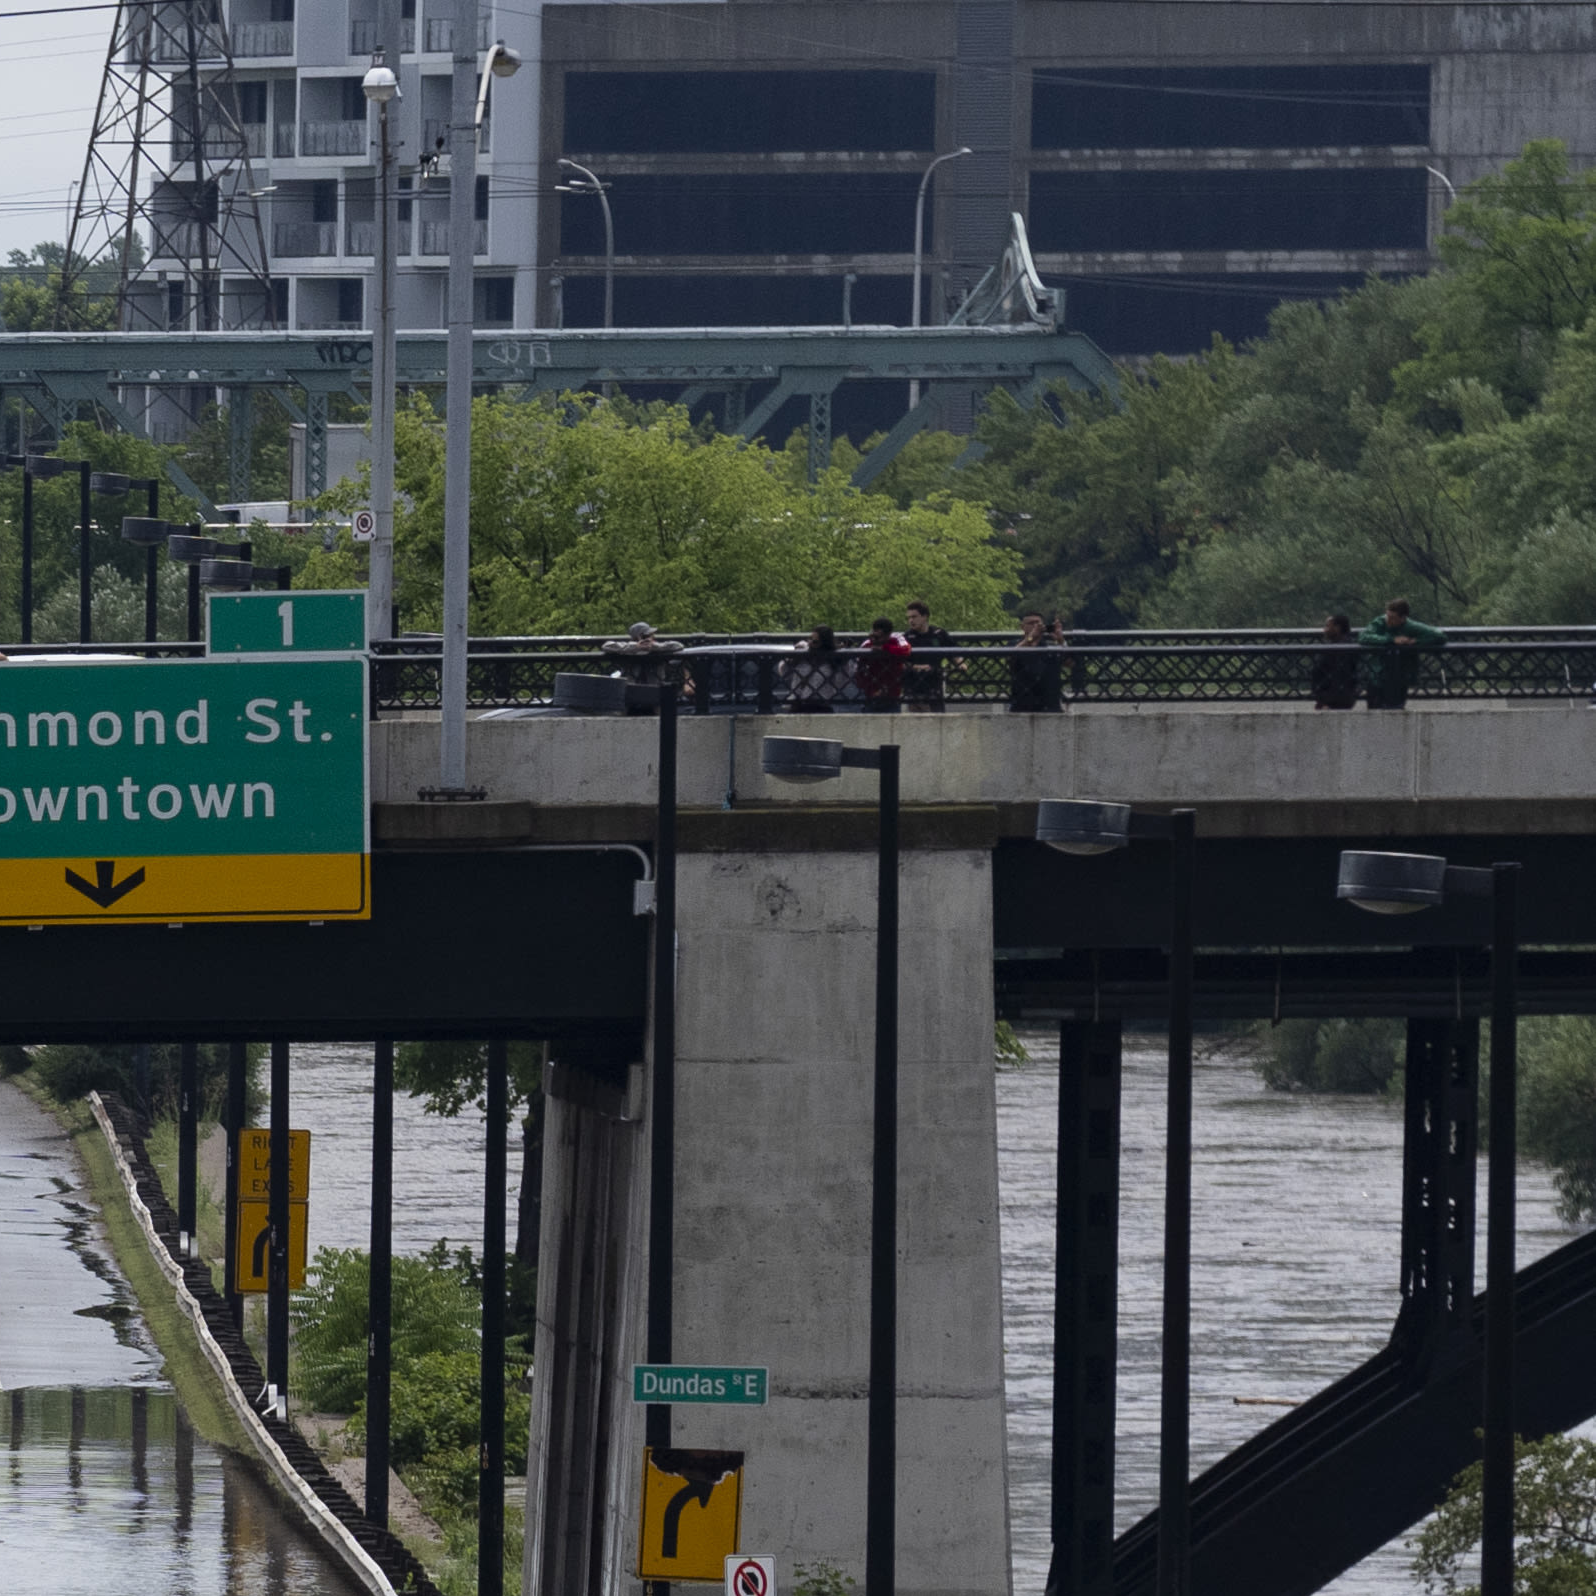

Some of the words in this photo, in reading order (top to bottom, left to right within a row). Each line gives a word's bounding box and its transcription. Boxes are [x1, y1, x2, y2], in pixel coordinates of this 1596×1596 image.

[278, 600, 294, 647] 1
[243, 697, 334, 744] St.
[252, 1135, 297, 1150] RIT
[254, 1157, 294, 1172] LAE
[252, 1179, 295, 1193] EXS
[642, 1372, 726, 1396] Dundas
[732, 1373, 743, 1385] St
[745, 1374, 758, 1396] E
